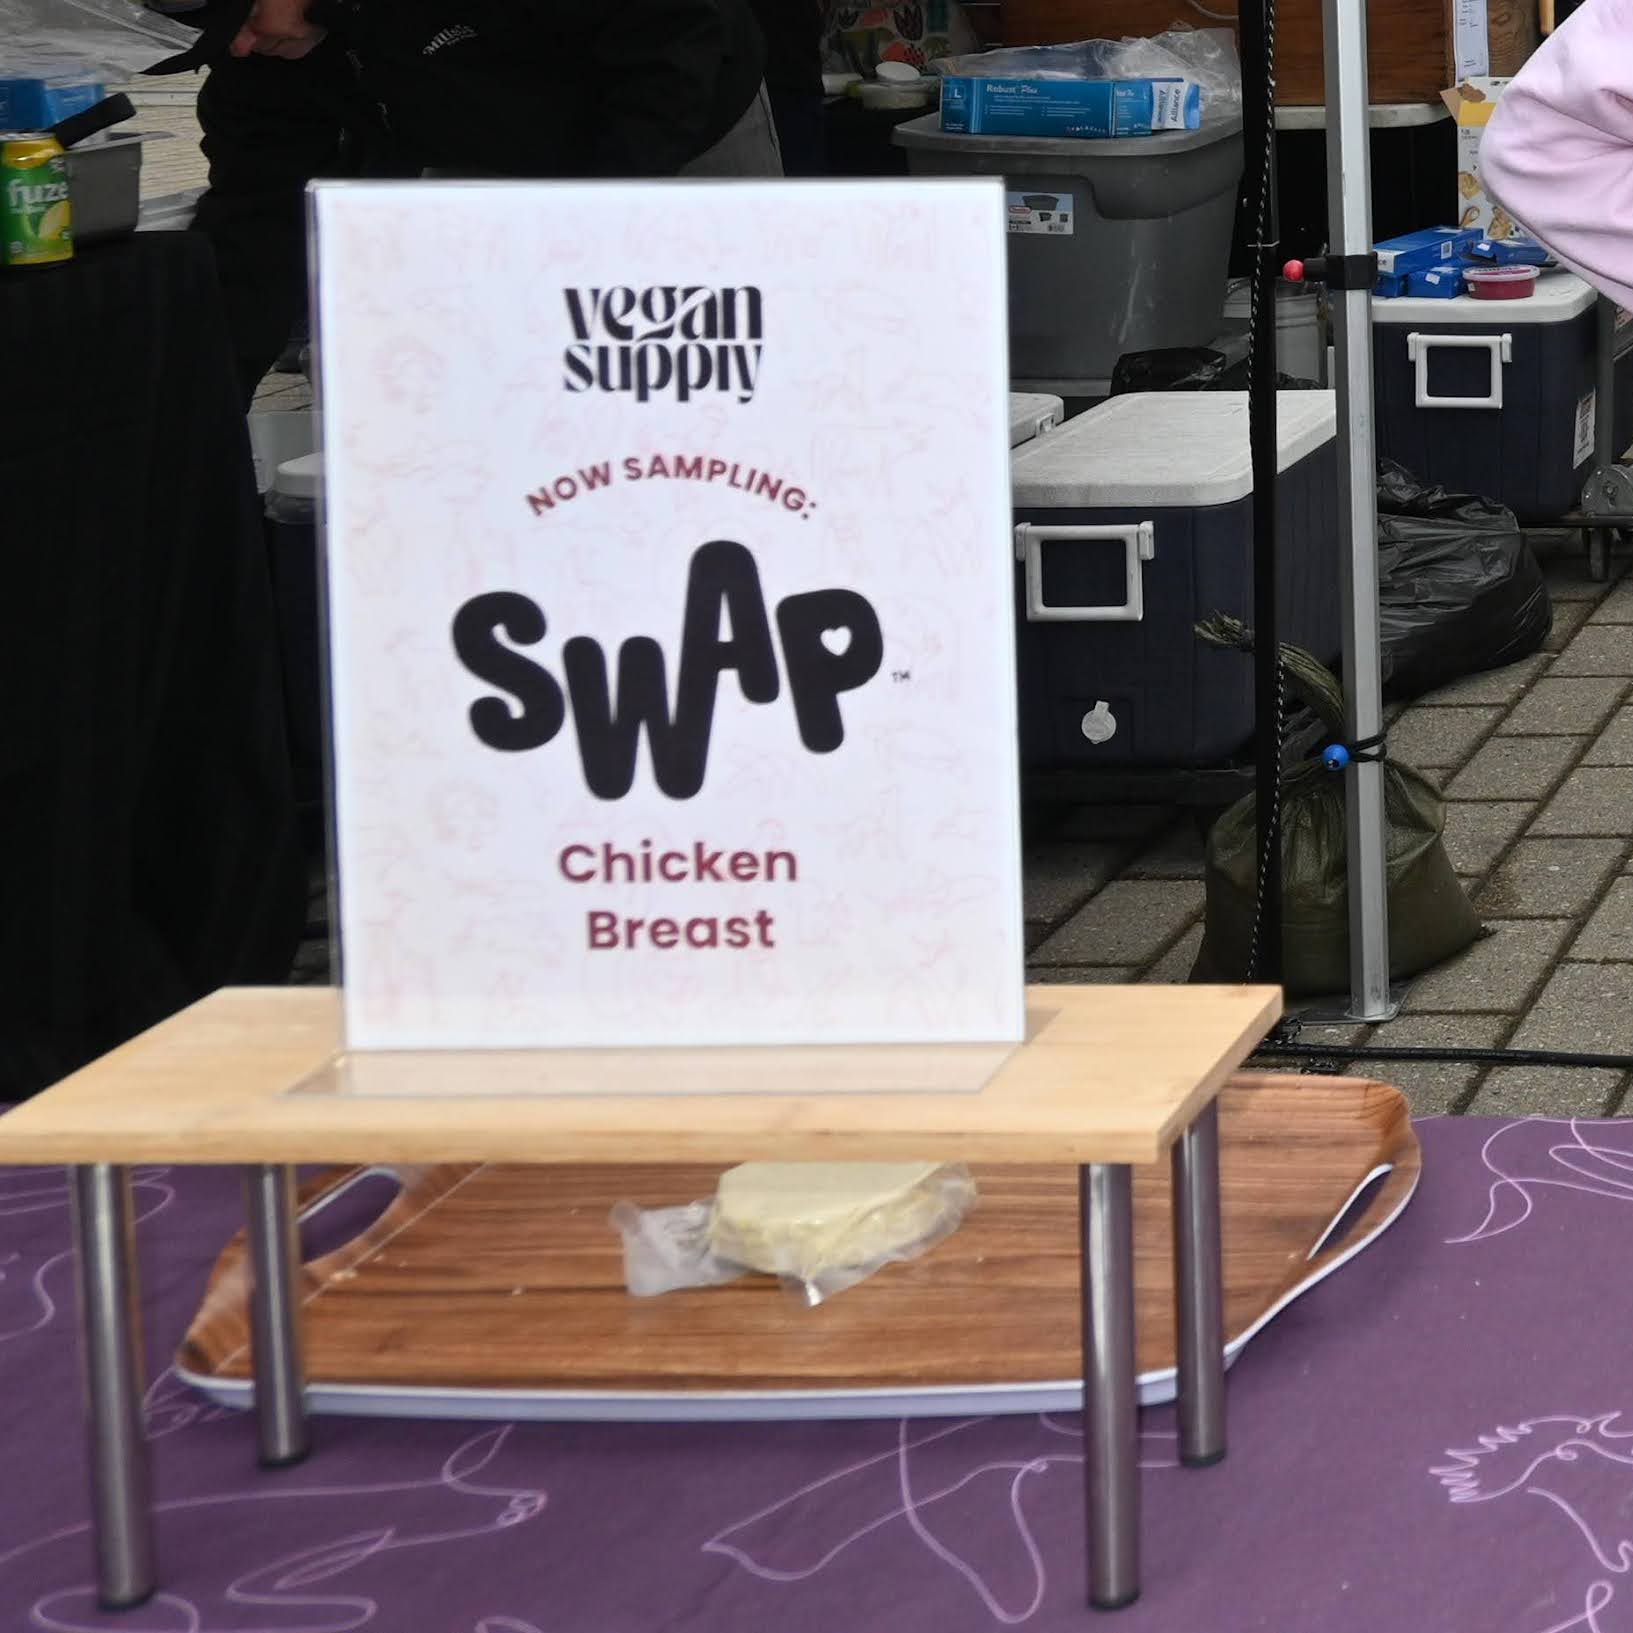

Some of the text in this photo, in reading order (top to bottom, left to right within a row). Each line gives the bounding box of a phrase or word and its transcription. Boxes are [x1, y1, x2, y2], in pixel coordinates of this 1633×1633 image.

[564, 285, 763, 342] vegan
[563, 339, 764, 404] supply
[526, 454, 819, 520] NOW SAMPLING:
[558, 840, 799, 885] Chicken
[586, 909, 777, 951] Breast
